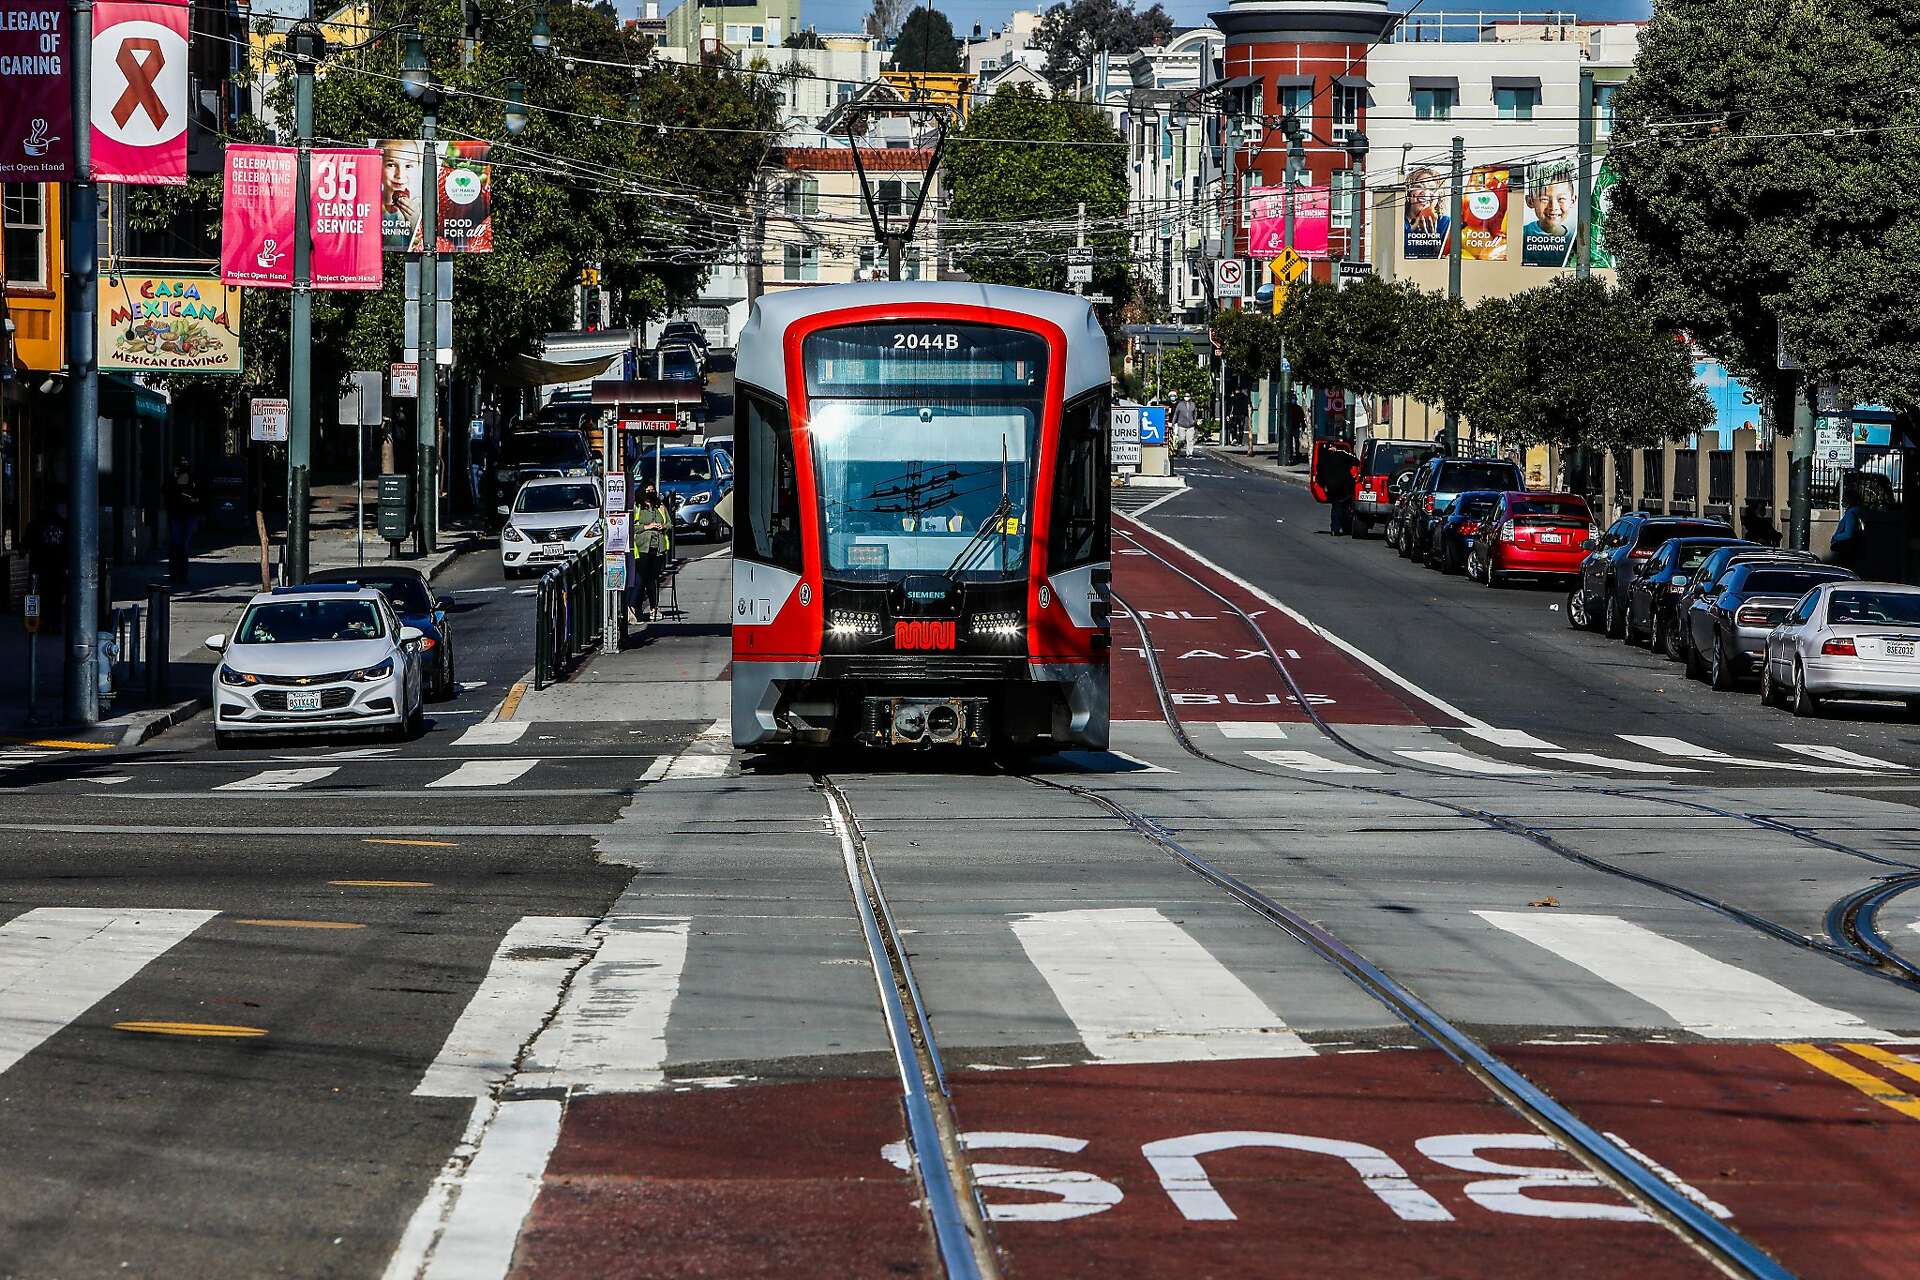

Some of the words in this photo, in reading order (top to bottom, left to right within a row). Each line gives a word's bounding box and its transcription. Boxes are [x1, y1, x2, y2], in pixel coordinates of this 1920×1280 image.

[0, 11, 60, 31] LEGACY
[40, 33, 61, 53] OF
[0, 55, 61, 75] CARING
[16, 163, 39, 173] Open
[41, 162, 65, 171] Hand
[232, 157, 291, 170] CELEBRATING
[232, 170, 290, 184] CELEBRATING
[317, 160, 357, 201] 35
[317, 203, 353, 217] YEARS
[356, 203, 371, 217] OF
[316, 219, 364, 234] SERVICE
[444, 219, 472, 228] FOOD
[444, 229, 464, 237] FOR
[466, 224, 486, 237] all
[1466, 231, 1490, 239] FOOD
[1485, 236, 1502, 248] all
[227, 271, 250, 279] Project
[269, 272, 287, 280] Hand
[140, 280, 201, 300] CASA
[111, 299, 231, 330] MEXICANA
[893, 333, 959, 350] 2044B
[111, 350, 168, 367] MEXICAN
[170, 353, 230, 368] CRAVINGS
[262, 416, 277, 424] ANY
[1115, 414, 1131, 424] NO
[1819, 419, 1827, 429] 2
[642, 422, 671, 431] METRO
[907, 591, 946, 599] SIEMENS
[1120, 647, 1302, 659] TAXI
[1170, 693, 1338, 706] BUS
[880, 1130, 1735, 1223] BUS
